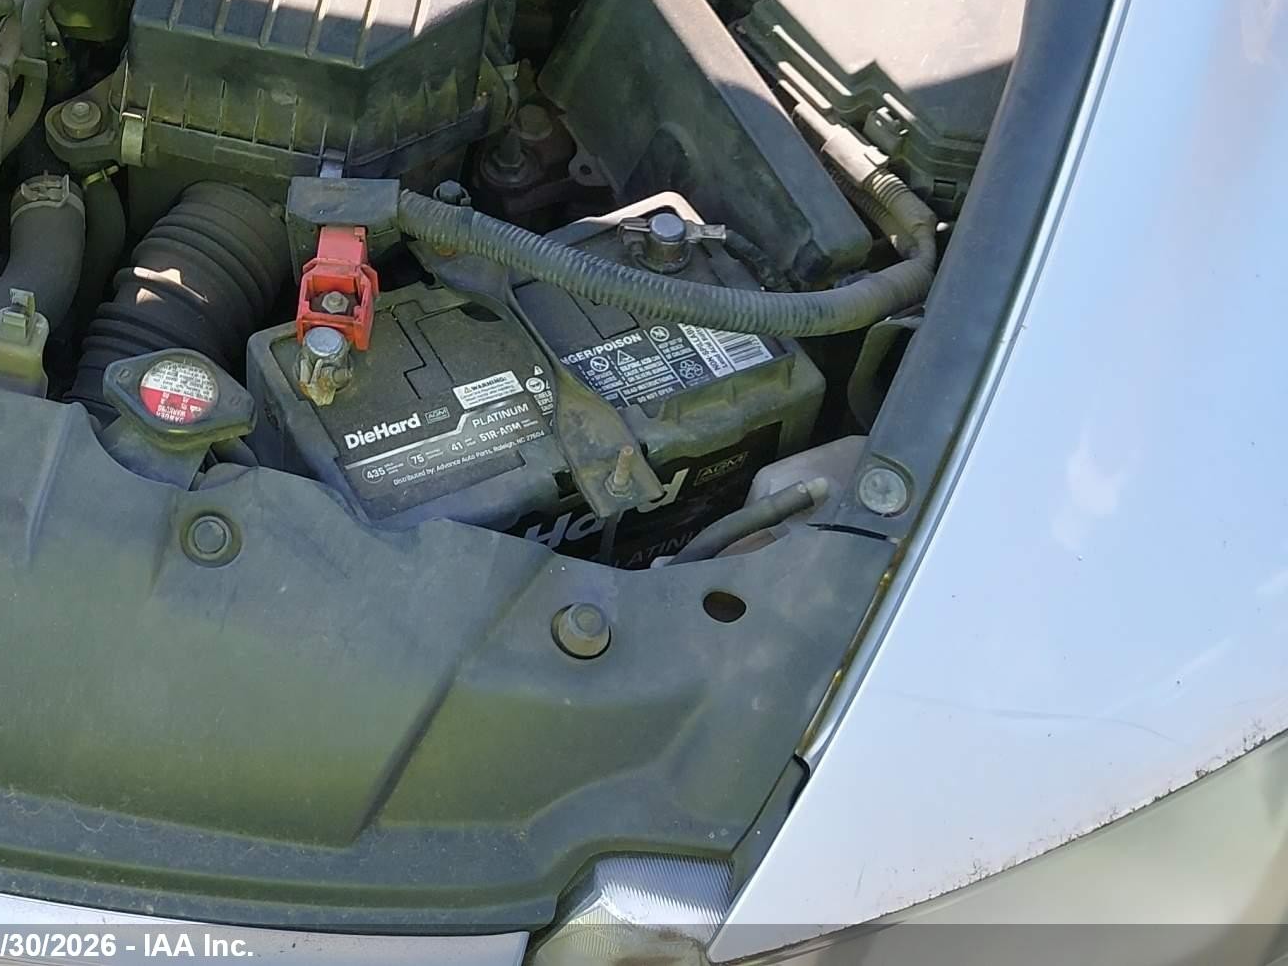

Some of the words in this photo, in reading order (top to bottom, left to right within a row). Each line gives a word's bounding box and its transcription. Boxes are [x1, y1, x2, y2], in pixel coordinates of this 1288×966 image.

[472, 403, 529, 428] PLATINUM
[344, 413, 421, 450] DieHard
[367, 467, 386, 479] 435
[410, 454, 425, 465] 75
[451, 442, 463, 451] 41
[479, 422, 522, 442] 51R-AGM
[461, 454, 476, 463] Auto
